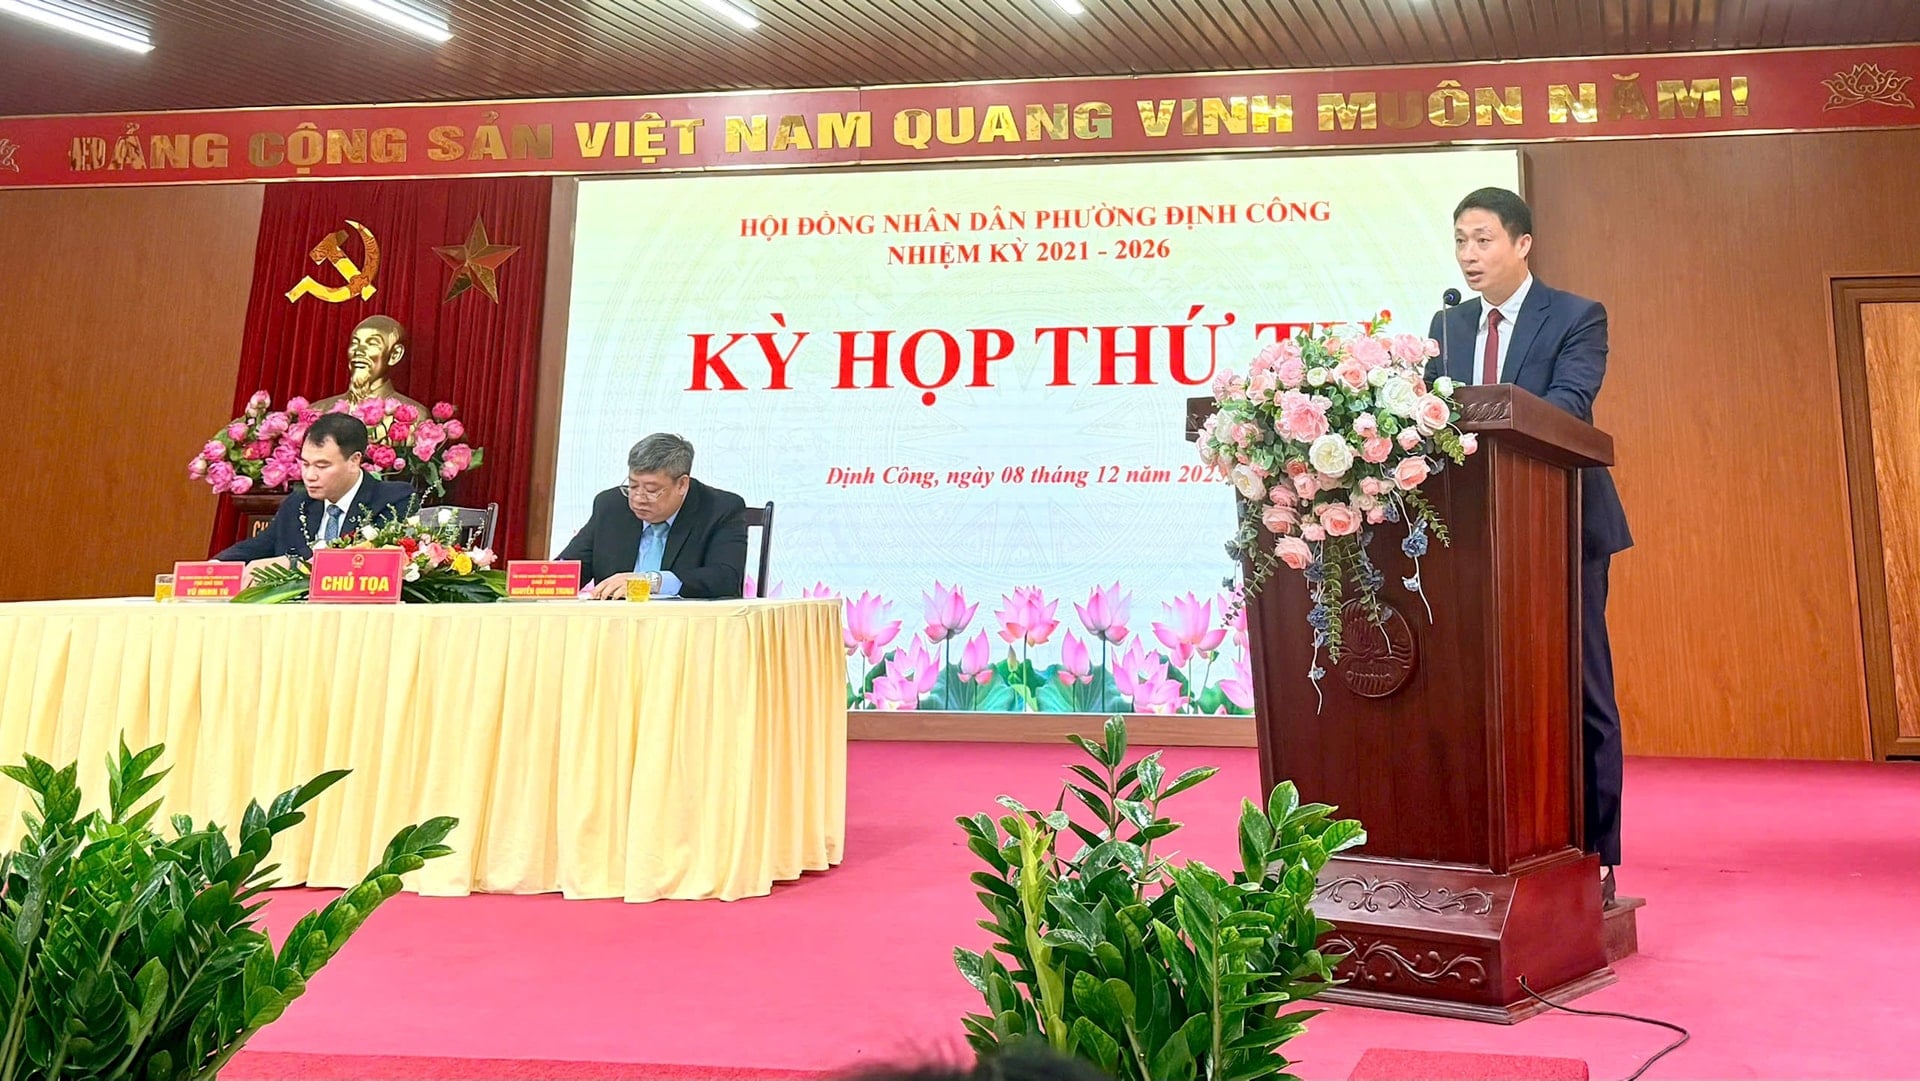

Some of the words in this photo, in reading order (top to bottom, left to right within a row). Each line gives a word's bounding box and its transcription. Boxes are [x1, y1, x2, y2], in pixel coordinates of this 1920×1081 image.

[68, 122, 229, 171] ĐẢNG
[249, 122, 407, 174] CỘNG
[427, 110, 553, 161] SẢN
[574, 112, 704, 163] VIỆT
[725, 111, 872, 153] NAM
[893, 101, 1113, 149] QUANG
[1136, 95, 1293, 137] VINH
[1317, 79, 1524, 131] MUÔN
[740, 214, 789, 241] HỘI
[797, 210, 875, 236] ĐỒNG
[884, 206, 960, 234] NHÂN
[970, 205, 1026, 231] DÂN
[1035, 202, 1157, 230] PHƯỜNG
[1165, 204, 1237, 230] ĐỊNH
[1246, 196, 1331, 223] CÔNG
[887, 241, 980, 269] NHIỆM
[989, 237, 1028, 263] KỲ
[1036, 240, 1089, 262] 2021
[1114, 238, 1170, 259] 2026
[683, 312, 810, 391] KỲ
[831, 328, 1015, 406] HỌP
[1035, 304, 1235, 387] THỨ
[826, 466, 876, 488] Định
[883, 466, 939, 488] Công,
[946, 466, 994, 488] ngày
[1001, 466, 1025, 484] 08
[1031, 465, 1089, 488] tháng
[1096, 465, 1120, 483] 12
[1126, 465, 1171, 483] năm
[321, 571, 355, 592] CHỦ
[359, 575, 390, 595] TỌA
